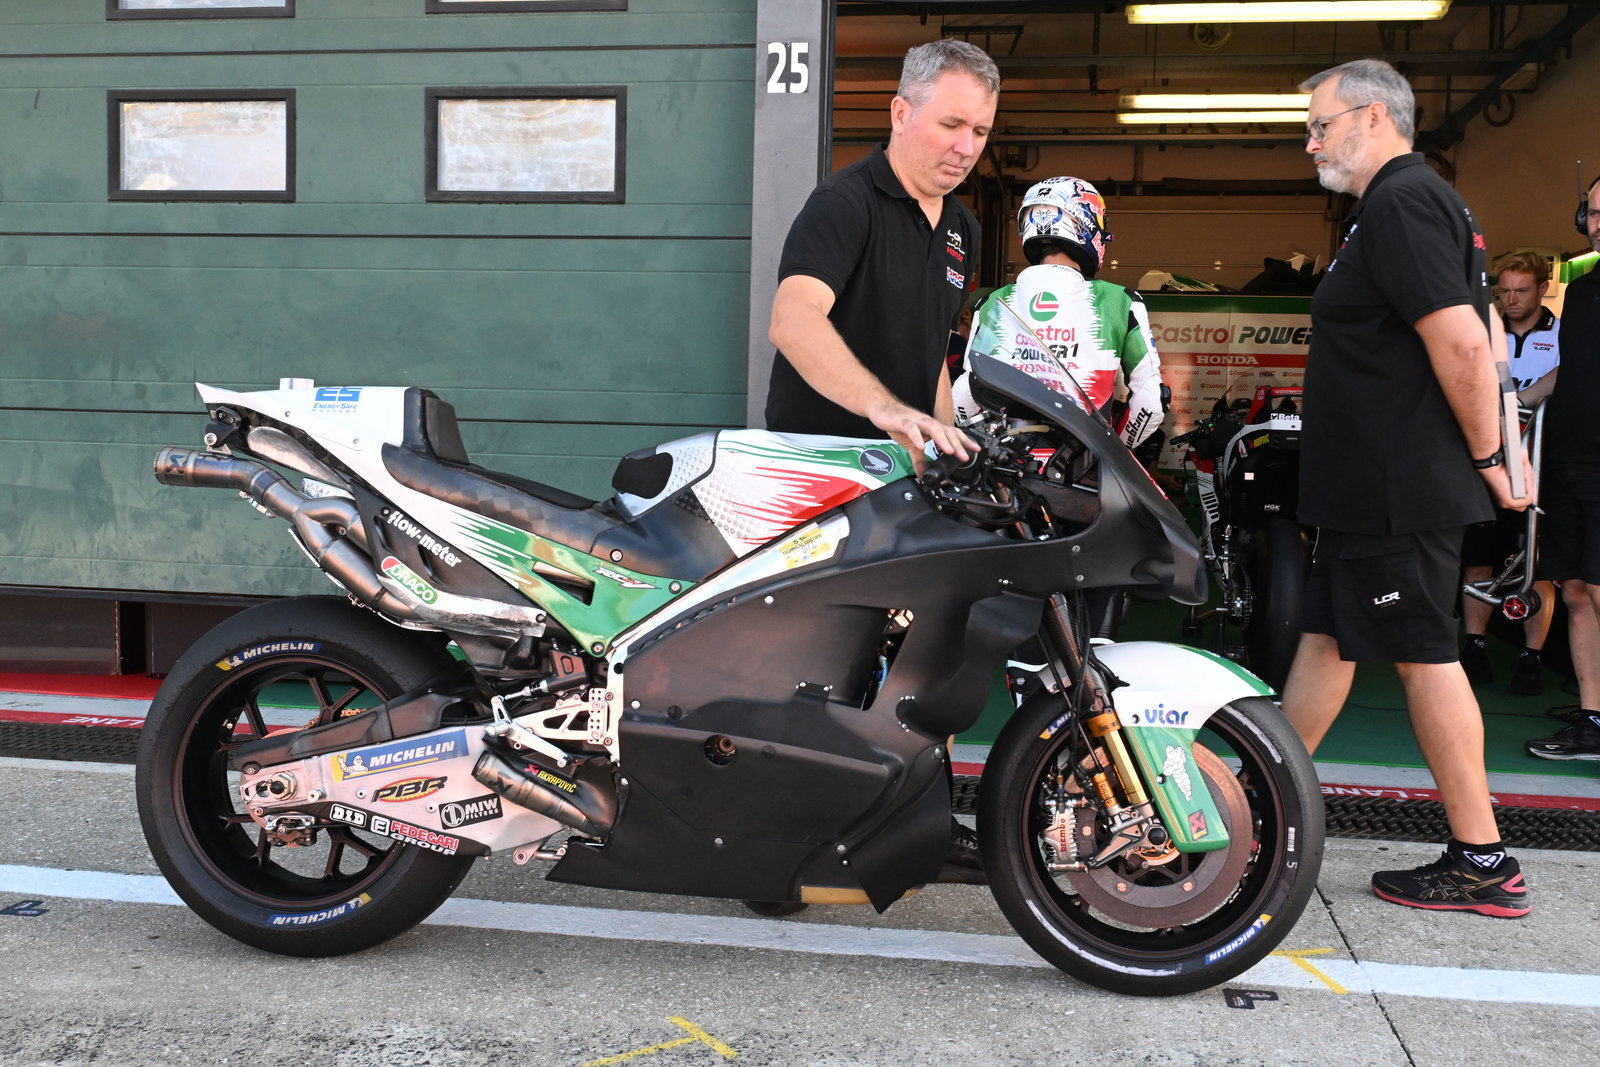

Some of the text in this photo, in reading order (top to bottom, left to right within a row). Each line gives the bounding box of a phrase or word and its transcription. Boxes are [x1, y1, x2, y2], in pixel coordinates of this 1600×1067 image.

[767, 42, 808, 93] 25
[1150, 323, 1312, 345] Castrol POWE
[1196, 355, 1259, 365] HONDA
[315, 387, 363, 402] ES
[1279, 413, 1300, 421] Beta
[864, 465, 889, 473] HONDA
[387, 510, 462, 568] flow-meter
[390, 564, 434, 601] DRACO
[1375, 591, 1401, 605] LCR
[243, 642, 315, 660] MICHELIN
[61, 715, 146, 727] LANE
[1144, 703, 1190, 725] viar
[369, 740, 456, 768] MICHELIN
[371, 776, 448, 803] PBR
[1320, 786, 1409, 798] LANE
[465, 798, 498, 814] MIW
[465, 808, 499, 821] FILTERS
[390, 821, 460, 851] FEDEGARI
[390, 833, 456, 856] GROUP
[1059, 818, 1067, 853] brembo
[273, 905, 346, 926] MICHELIN
[1209, 928, 1257, 963] MICHELIN
